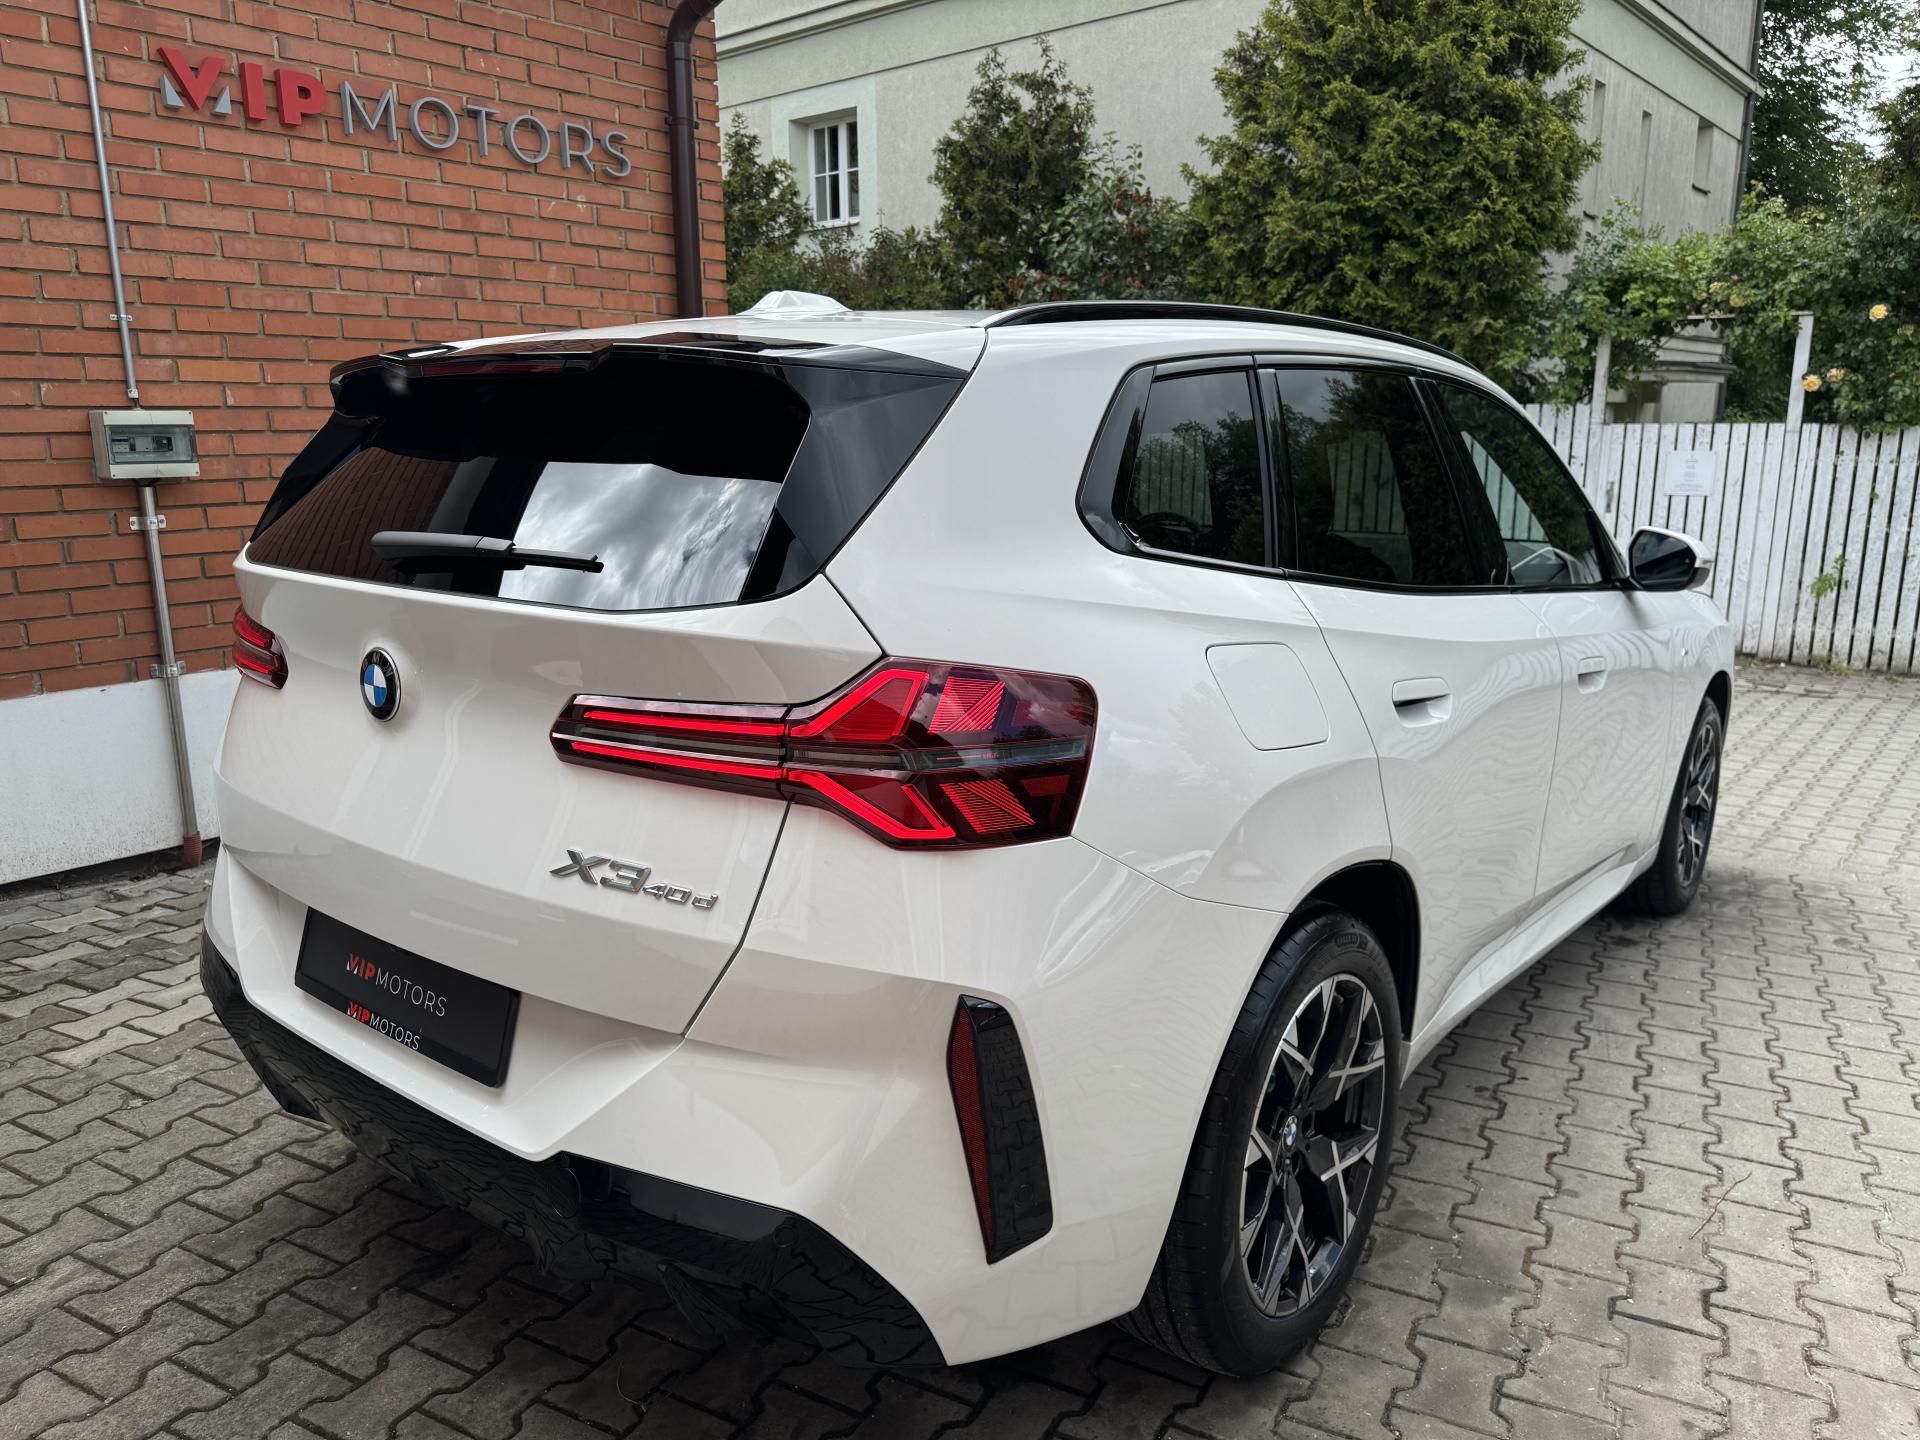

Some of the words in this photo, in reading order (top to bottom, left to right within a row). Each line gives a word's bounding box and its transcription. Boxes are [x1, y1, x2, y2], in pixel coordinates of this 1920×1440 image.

[158, 47, 327, 127] VIP
[339, 81, 632, 178] MOTORS
[549, 849, 651, 893] X3
[346, 953, 376, 981] VIP
[375, 968, 447, 1017] MOTORS
[347, 1001, 371, 1024] VIP
[369, 1013, 421, 1051] MOTORS
